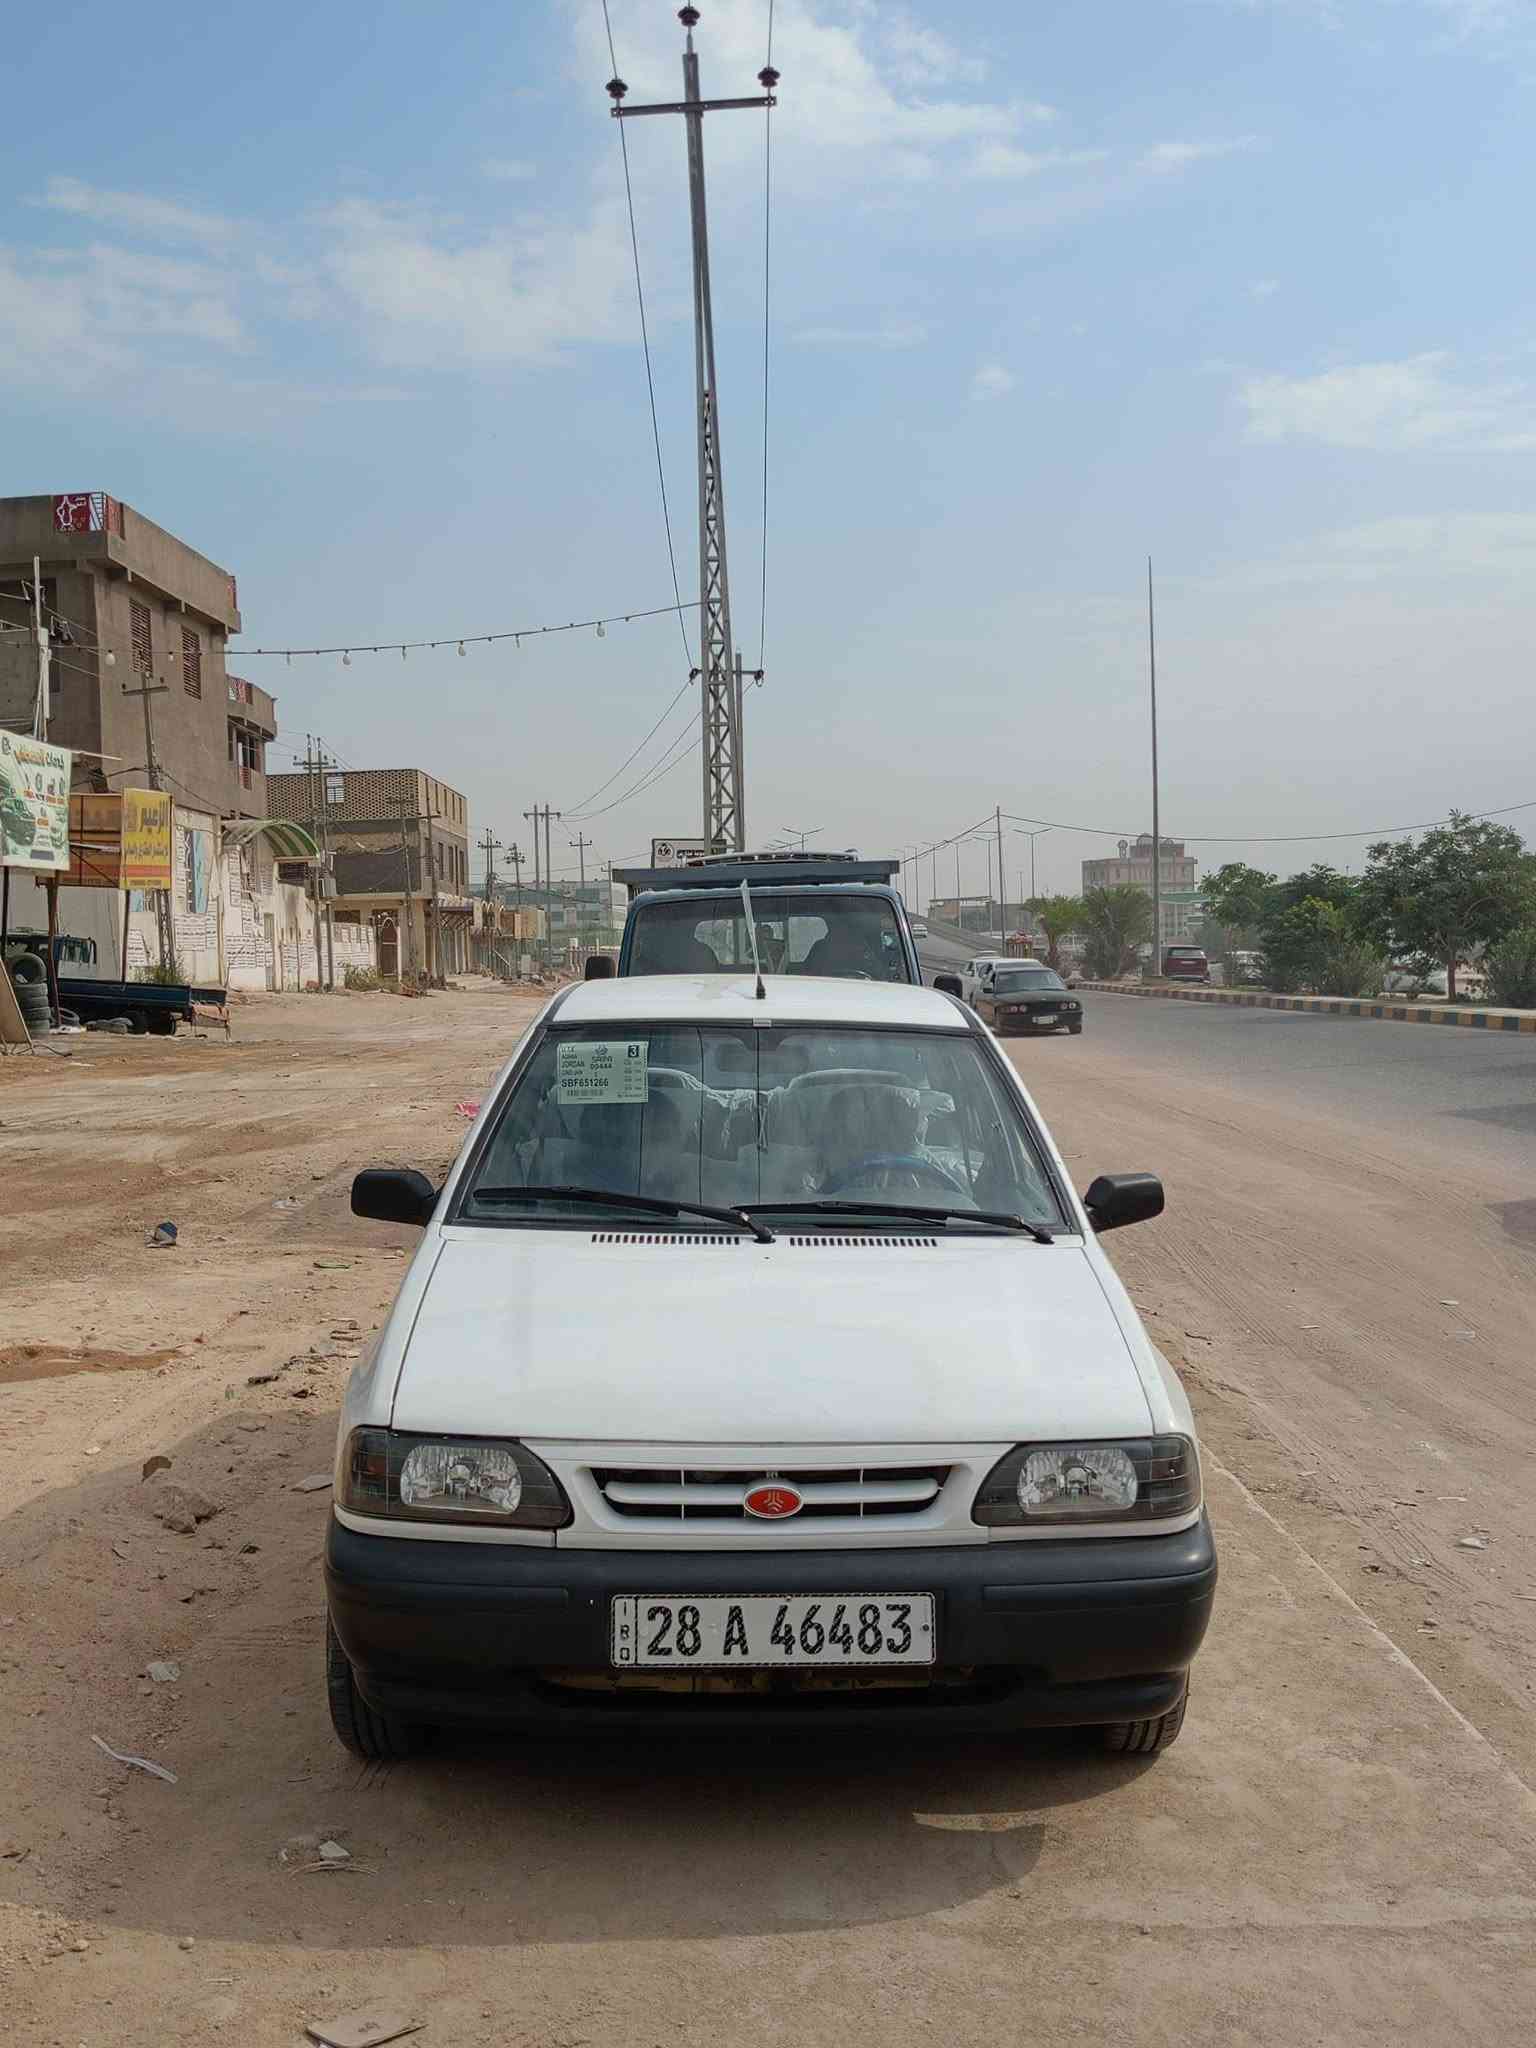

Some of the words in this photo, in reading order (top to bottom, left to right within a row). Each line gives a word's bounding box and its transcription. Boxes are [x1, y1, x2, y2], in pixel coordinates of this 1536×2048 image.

[629, 1045, 638, 1056] 3
[647, 1605, 701, 1657] 28
[723, 1604, 749, 1656] A
[770, 1604, 912, 1656] 46483
